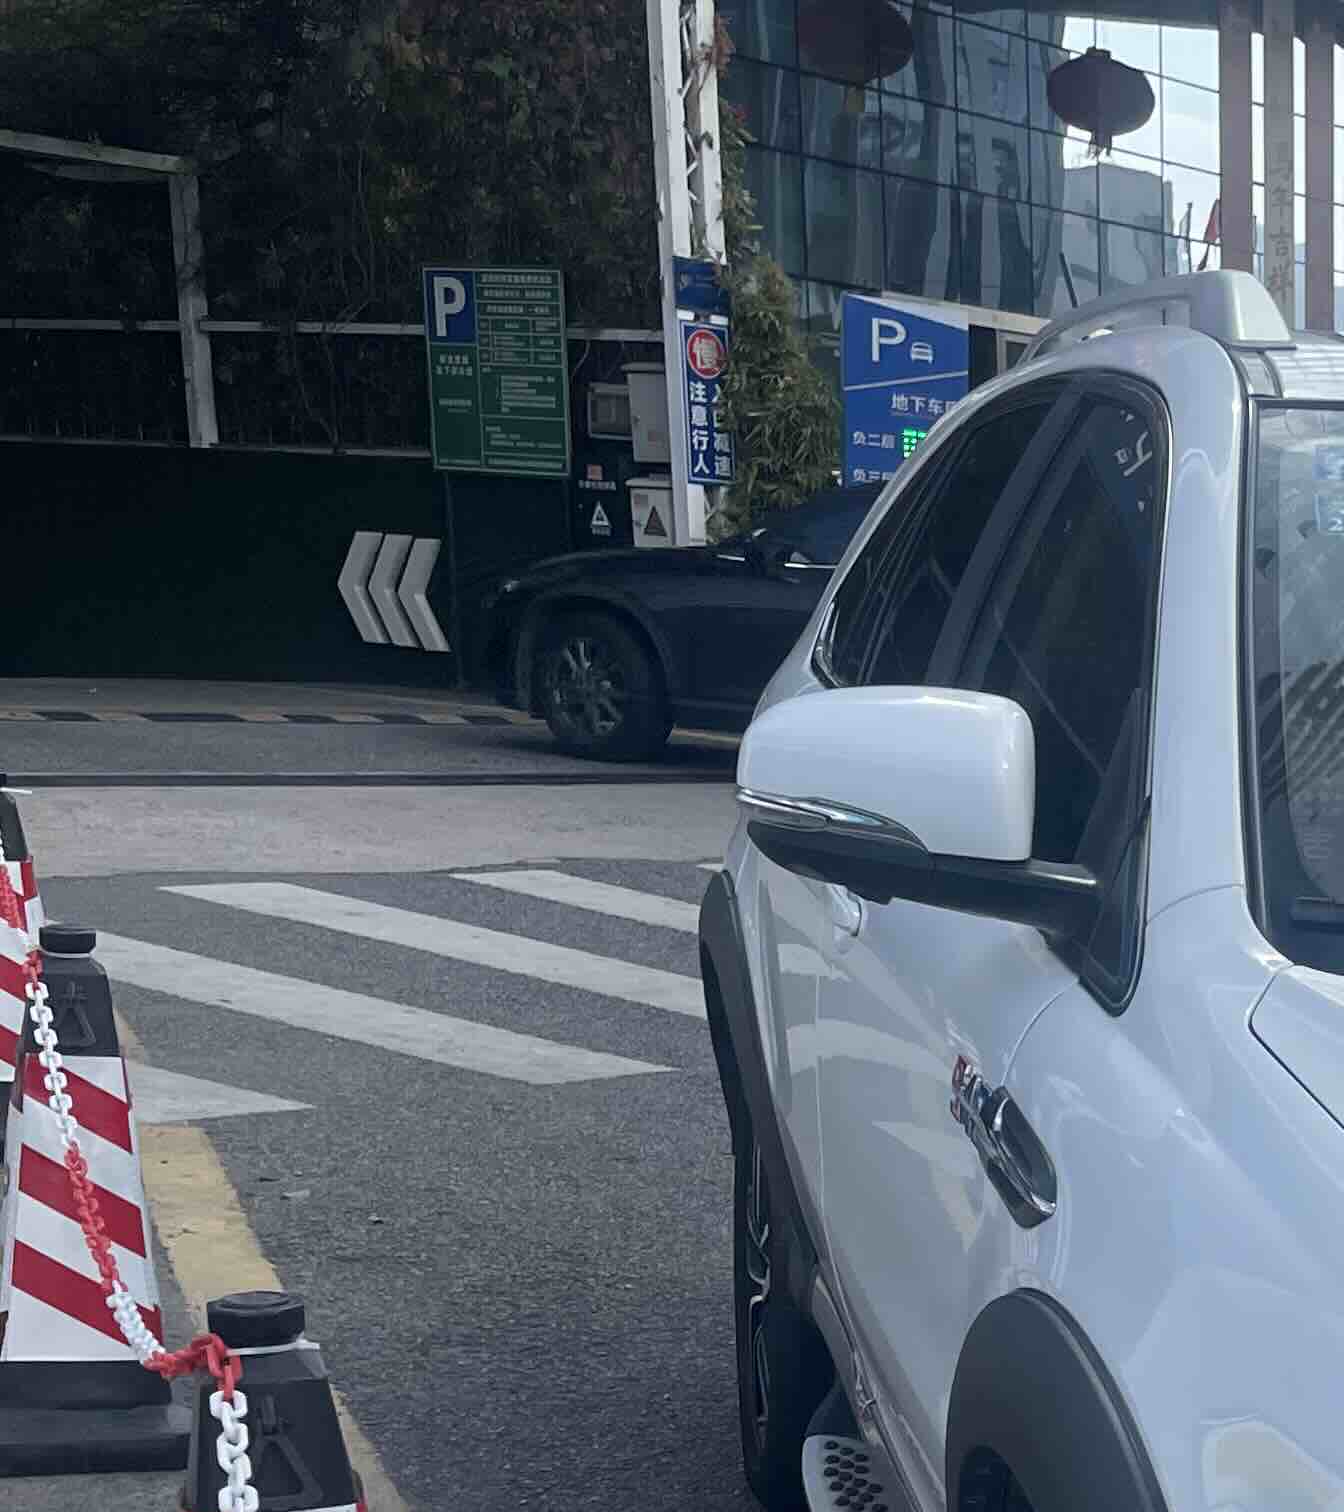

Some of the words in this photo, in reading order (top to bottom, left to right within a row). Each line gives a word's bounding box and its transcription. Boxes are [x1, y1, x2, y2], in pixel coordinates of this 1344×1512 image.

[433, 276, 466, 337] P
[693, 336, 720, 370] 慢
[871, 317, 907, 363] P
[689, 381, 710, 474] 注意行人
